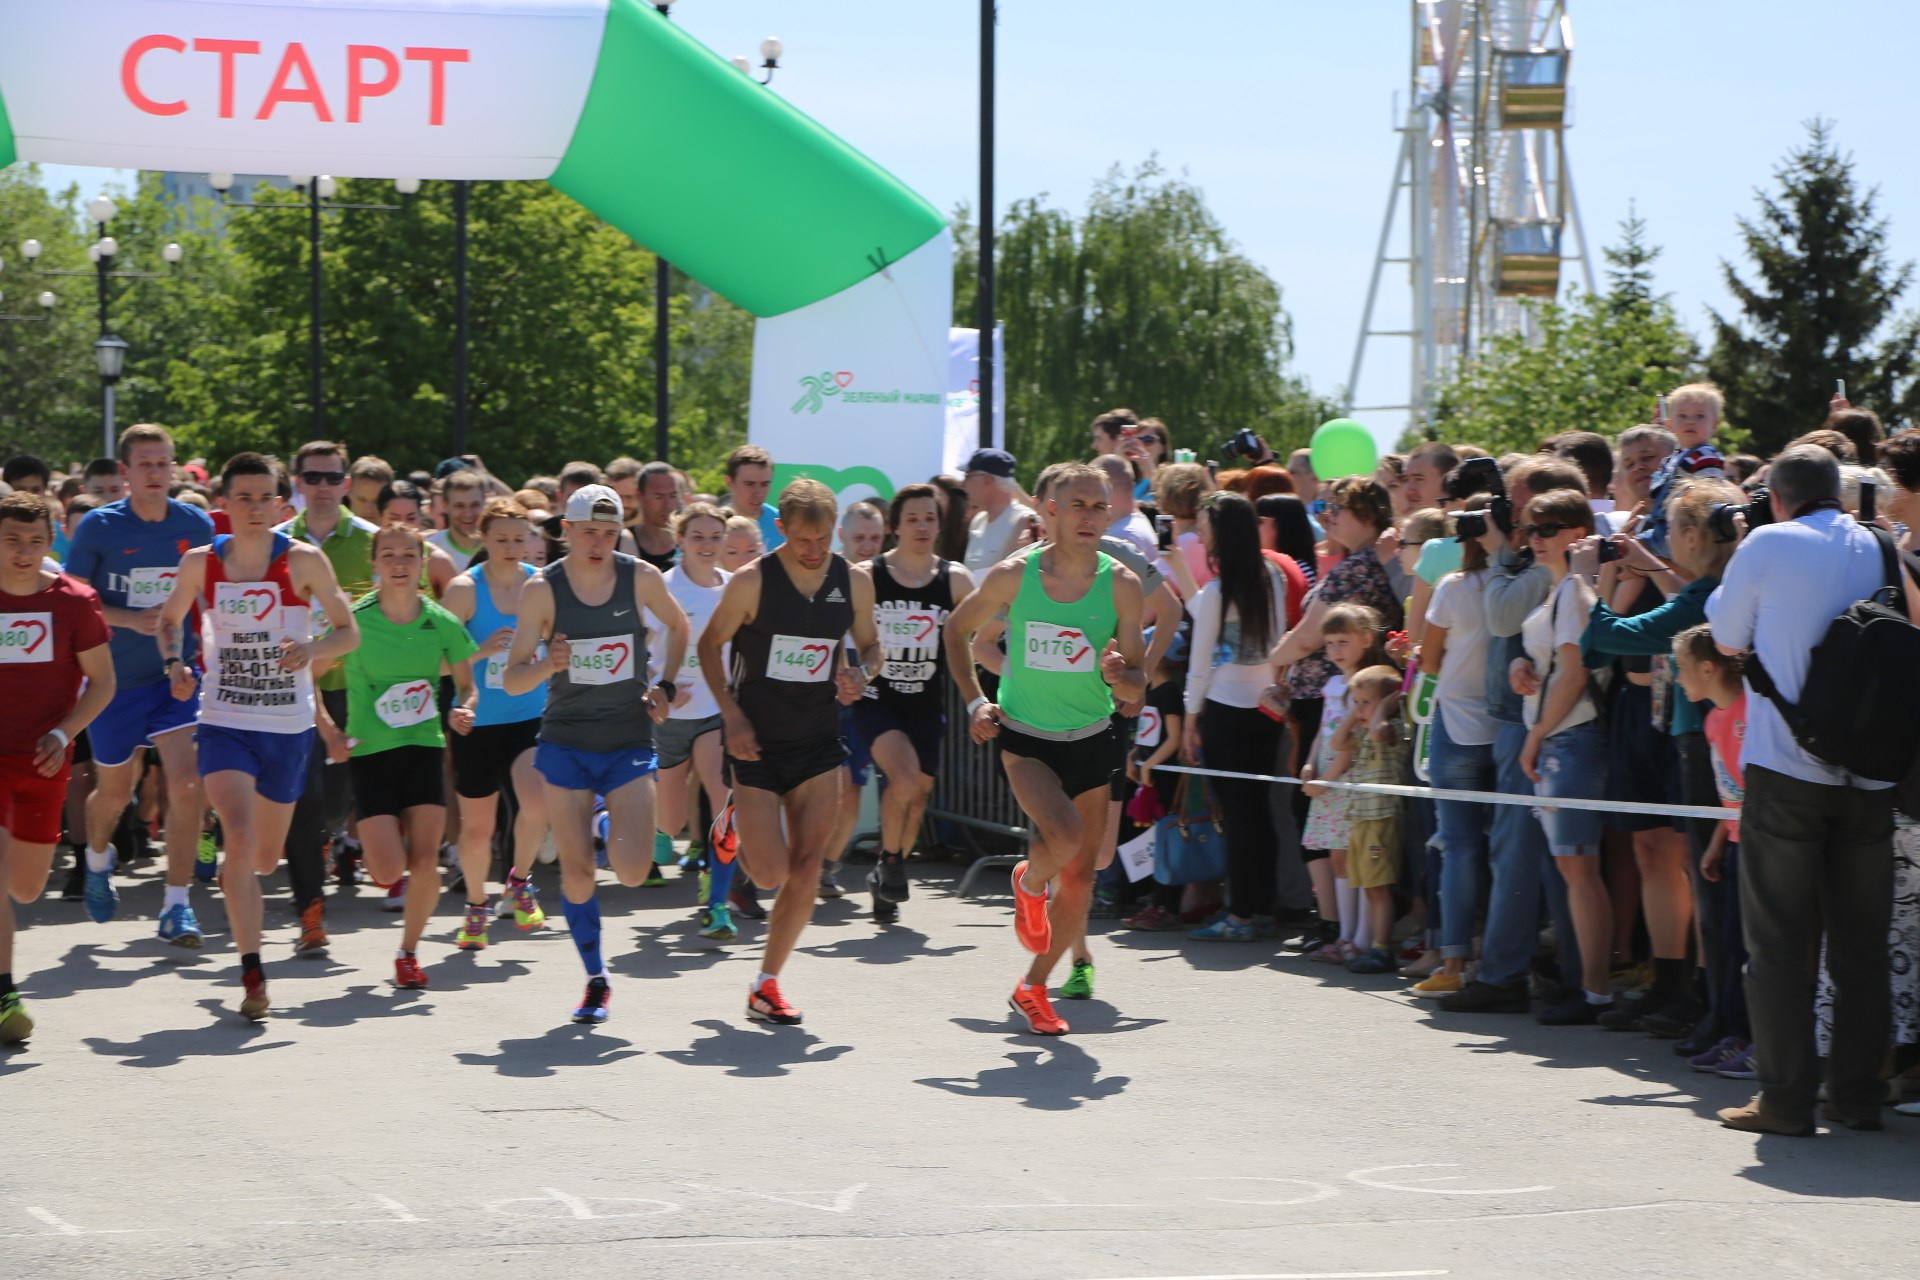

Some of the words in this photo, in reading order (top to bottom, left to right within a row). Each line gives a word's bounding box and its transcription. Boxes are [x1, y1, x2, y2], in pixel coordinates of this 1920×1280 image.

[121, 34, 470, 125] СТАРТ
[133, 581, 171, 594] 0614
[218, 599, 258, 614] 1361
[884, 622, 920, 635] 1657
[1028, 637, 1074, 656] 0176
[572, 653, 614, 670] 0485
[774, 649, 817, 668] 1446
[380, 695, 420, 715] 1610
